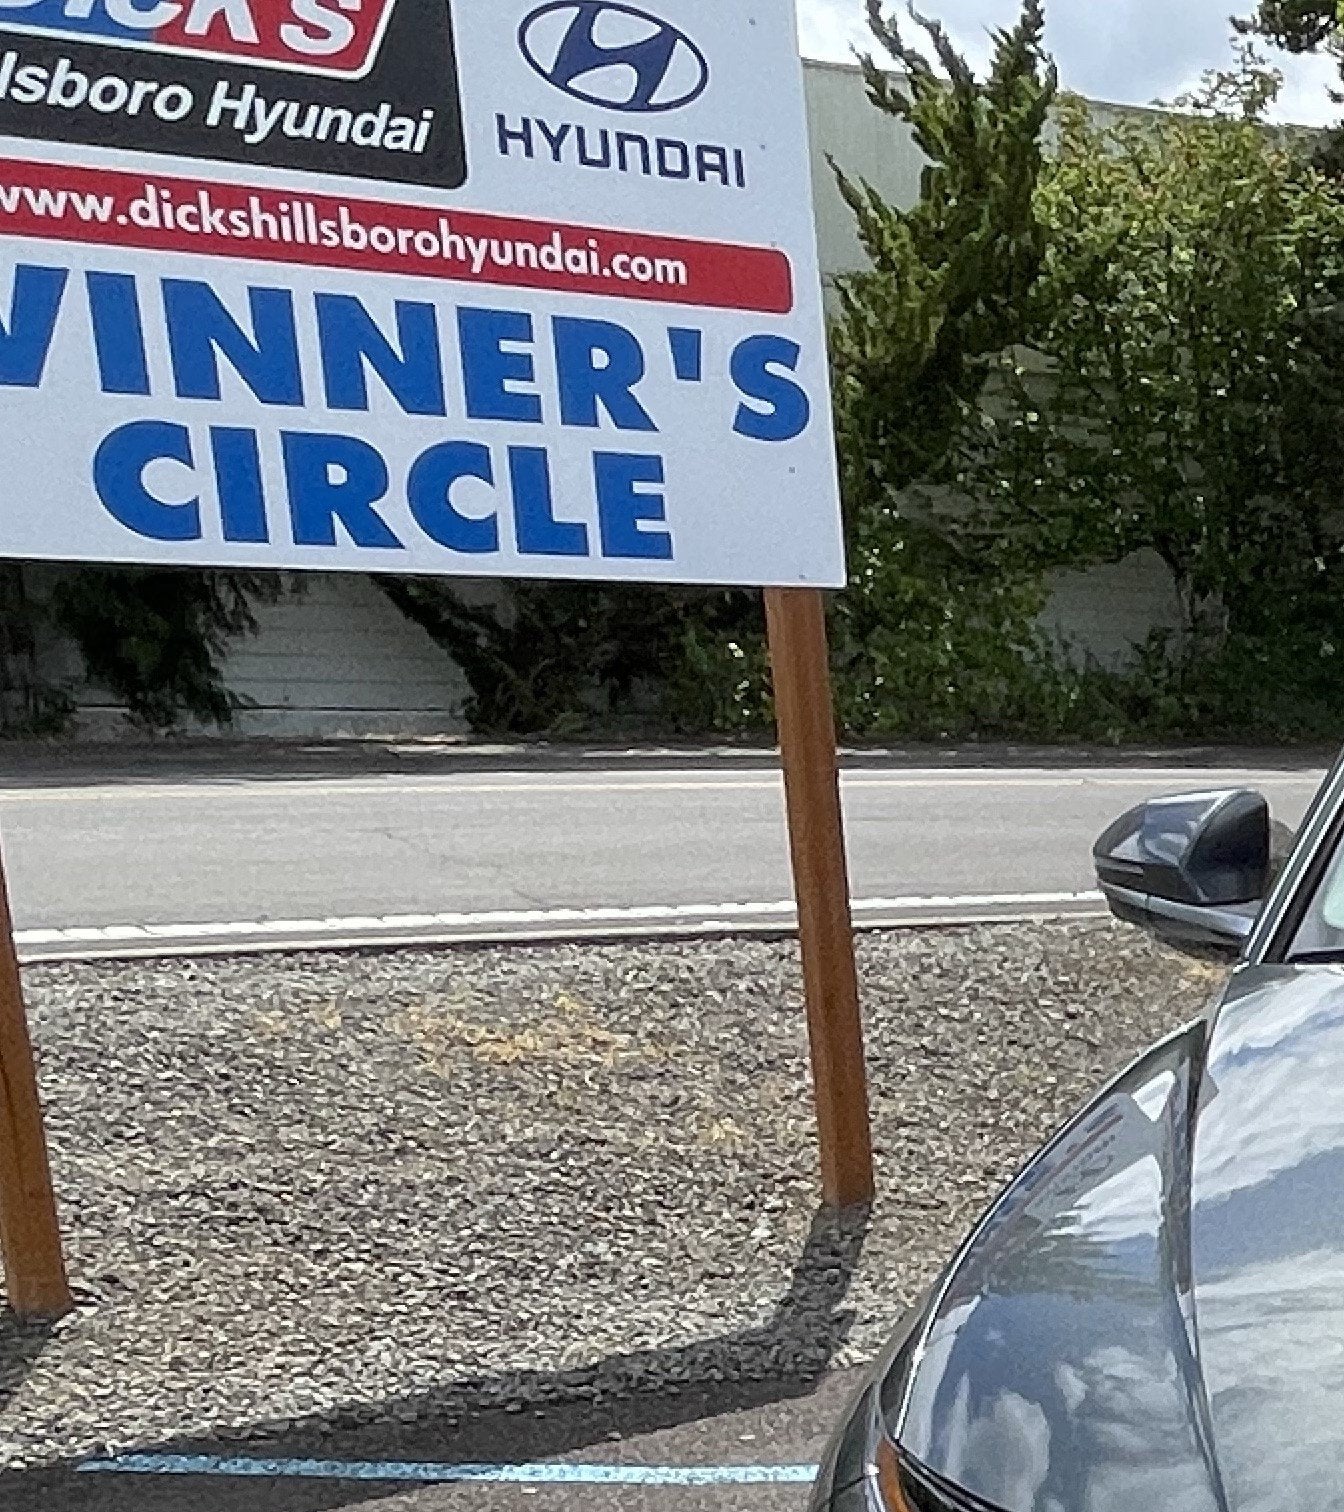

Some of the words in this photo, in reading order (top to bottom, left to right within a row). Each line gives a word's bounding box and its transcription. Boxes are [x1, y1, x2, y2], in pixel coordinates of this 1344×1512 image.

[206, 79, 435, 153] Hyundai
[495, 112, 746, 188] HYUNDAI
[92, 420, 674, 560] CIRCLE
